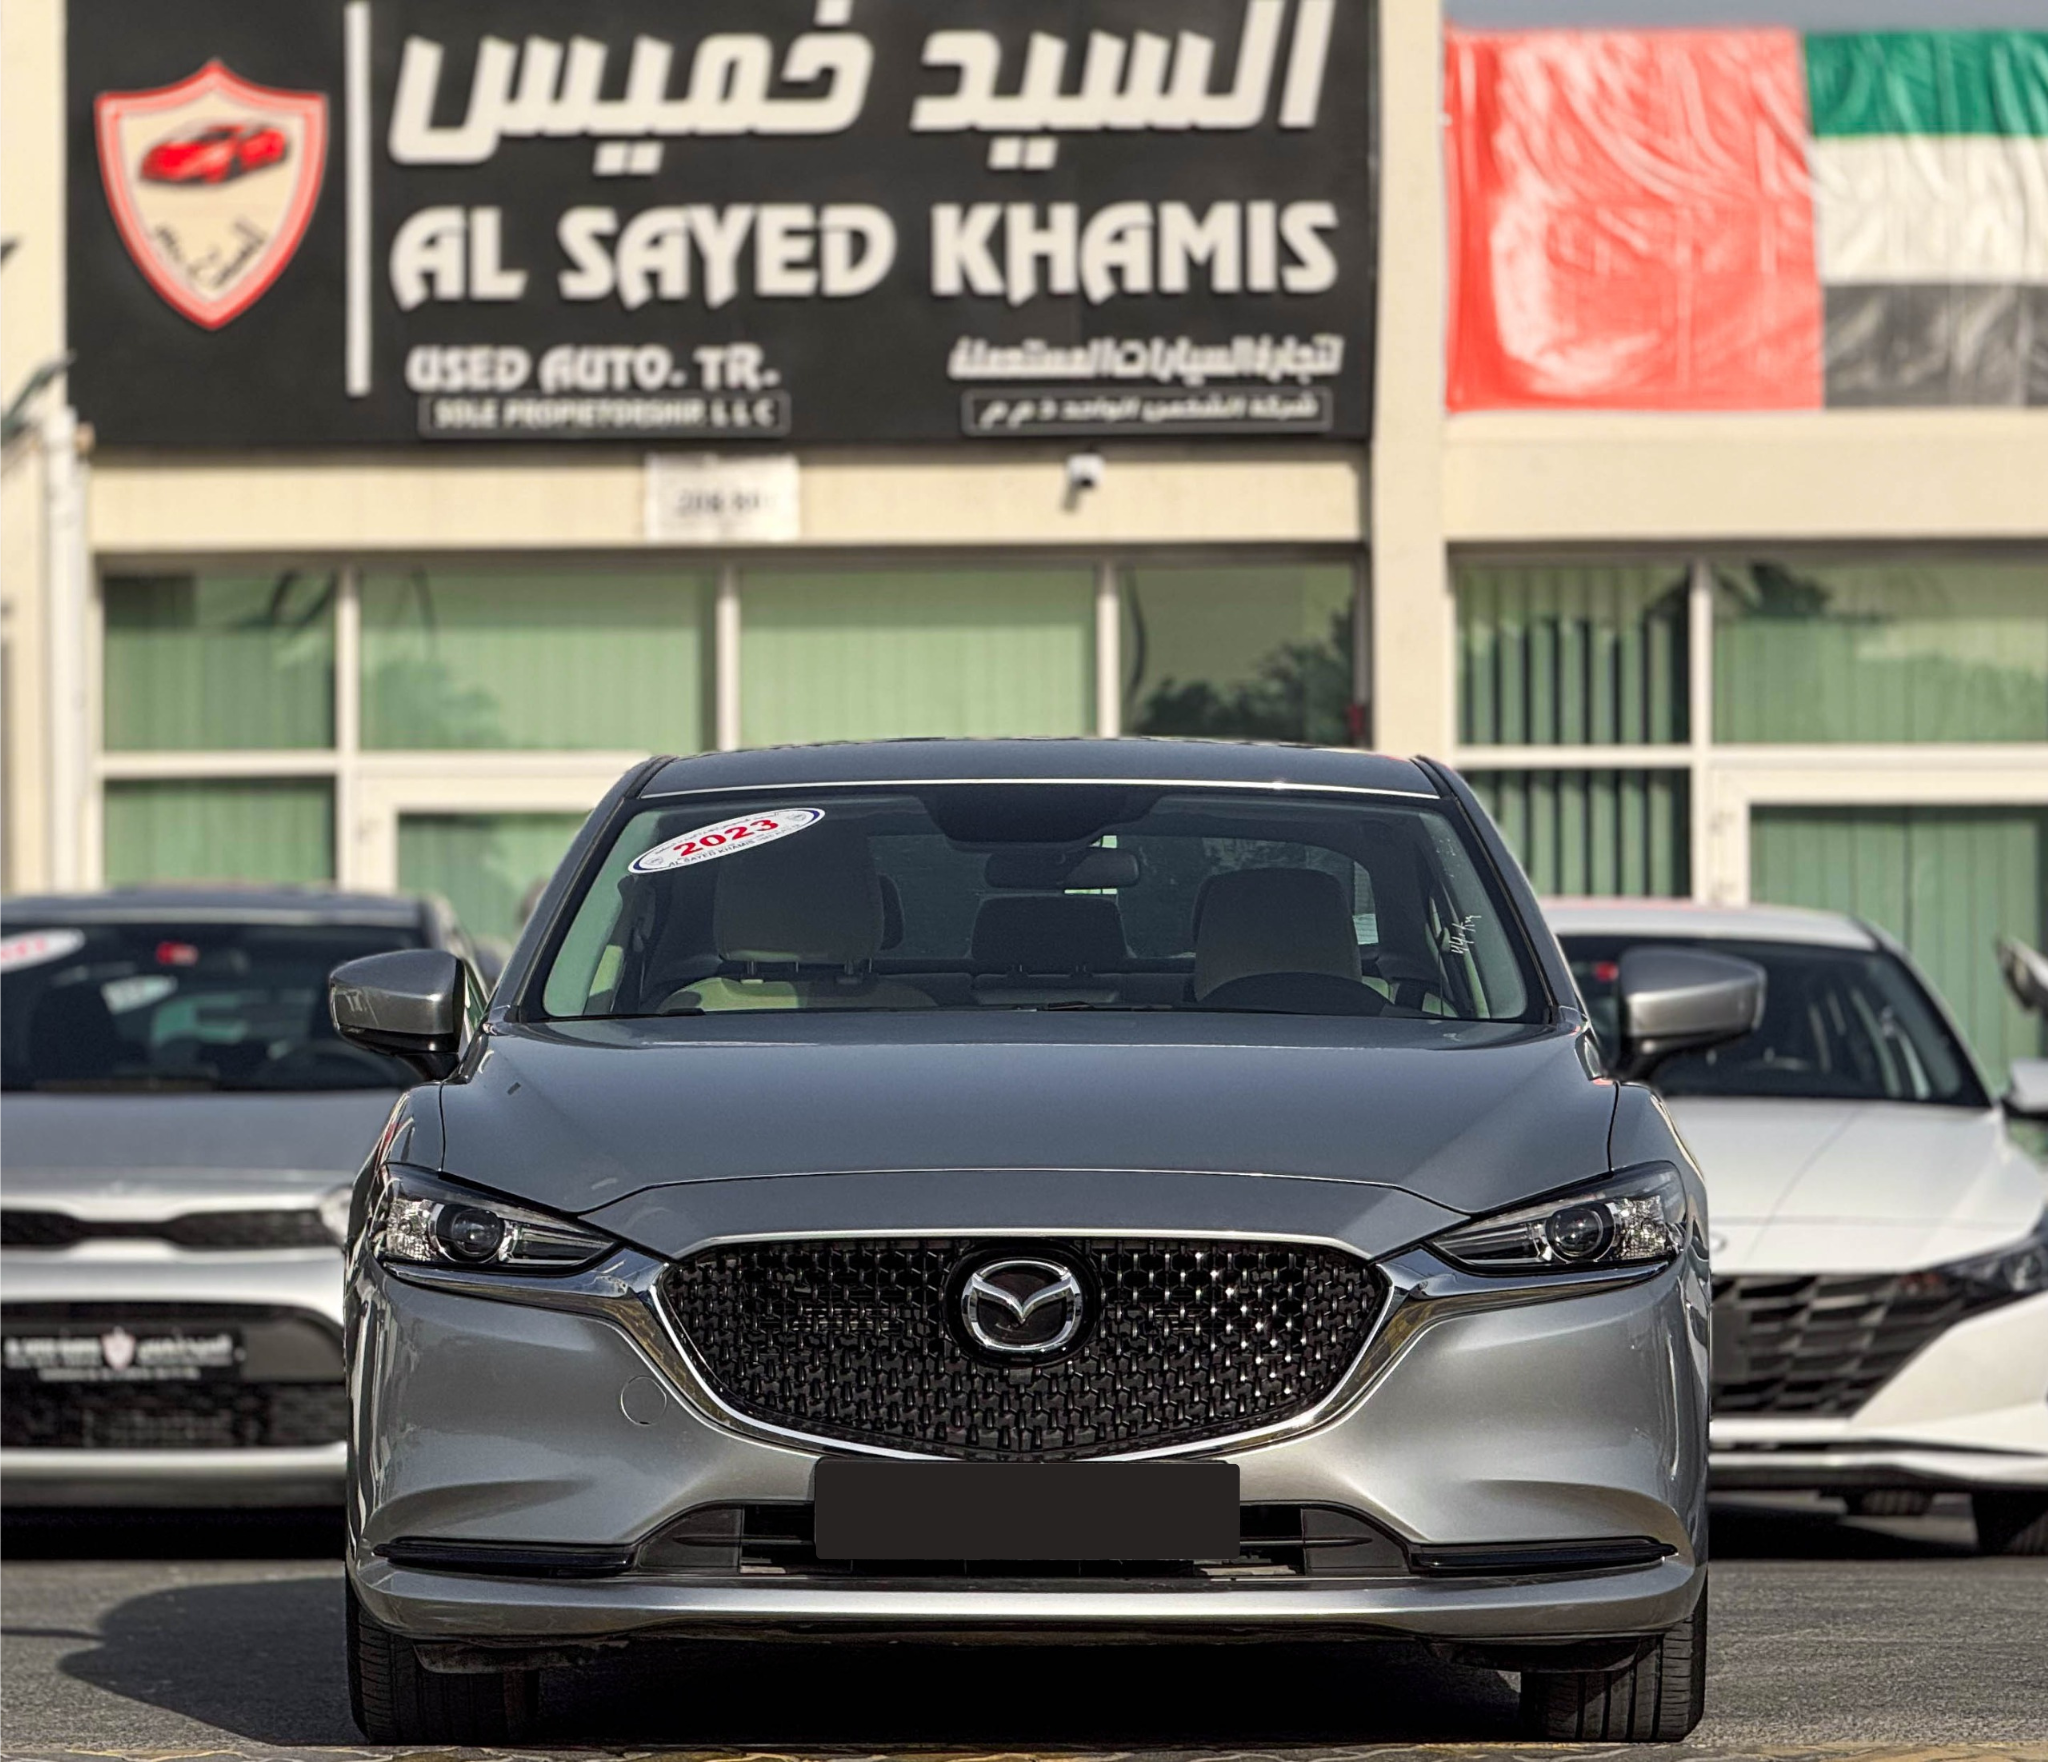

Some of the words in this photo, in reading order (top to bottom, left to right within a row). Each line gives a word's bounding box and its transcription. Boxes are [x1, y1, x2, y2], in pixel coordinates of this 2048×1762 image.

[388, 0, 874, 175] خميس
[910, 0, 1336, 170] السيد
[390, 206, 528, 310] AL
[557, 203, 897, 308] SAYED
[931, 201, 1338, 304] KHAMIS
[405, 345, 531, 392] USED
[694, 343, 780, 391] TR.
[673, 818, 779, 857] 2023
